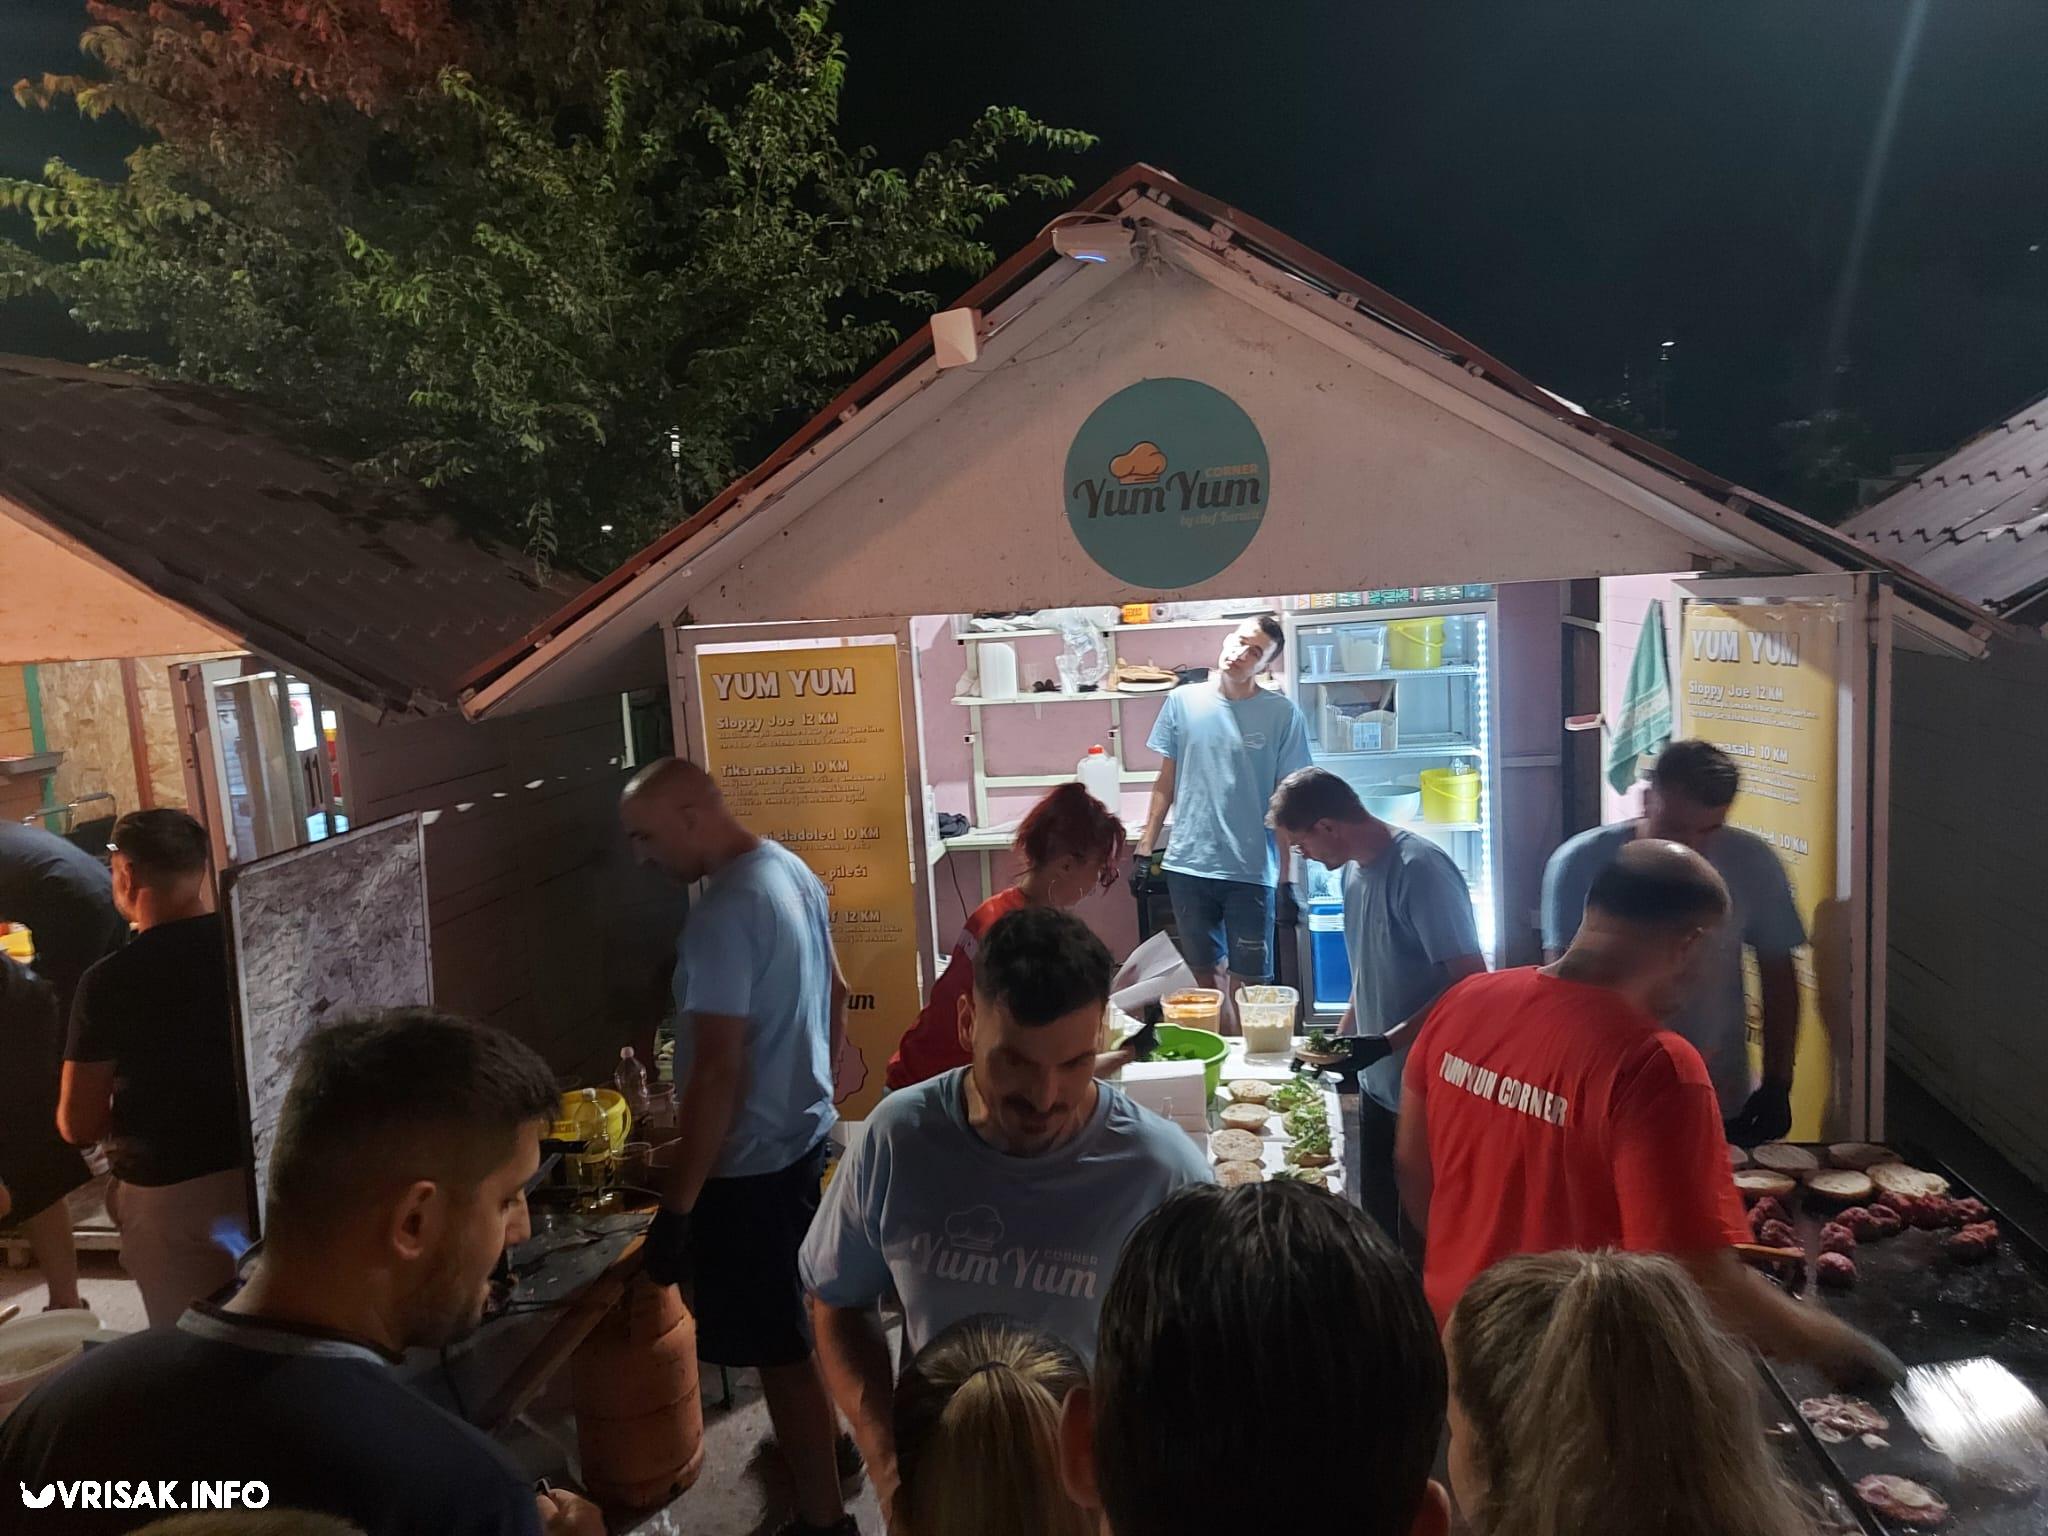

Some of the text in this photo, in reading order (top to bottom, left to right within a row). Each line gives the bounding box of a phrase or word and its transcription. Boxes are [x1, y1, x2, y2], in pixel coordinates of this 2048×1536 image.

[1073, 470, 1261, 518] Yum Yum
[1691, 630, 1799, 667] YUM YUM
[712, 667, 855, 700] YUM YUM
[1688, 680, 1725, 700] Sloppy
[1728, 685, 1750, 698] Joe
[1755, 686, 1767, 699] 12
[716, 712, 838, 732] Sloppy Joe 12 KM
[1760, 746, 1770, 760] 10
[1773, 747, 1788, 764] KM
[720, 760, 849, 777] Tika masala 10 KM
[843, 828, 856, 840] 10
[860, 827, 880, 839] KM
[1780, 834, 1808, 855] 10 KM
[845, 911, 858, 922] 12
[861, 911, 880, 922] KM
[847, 994, 876, 1010] um
[1498, 1076, 1568, 1127] CORNER
[911, 1232, 1096, 1299] Yum Yum
